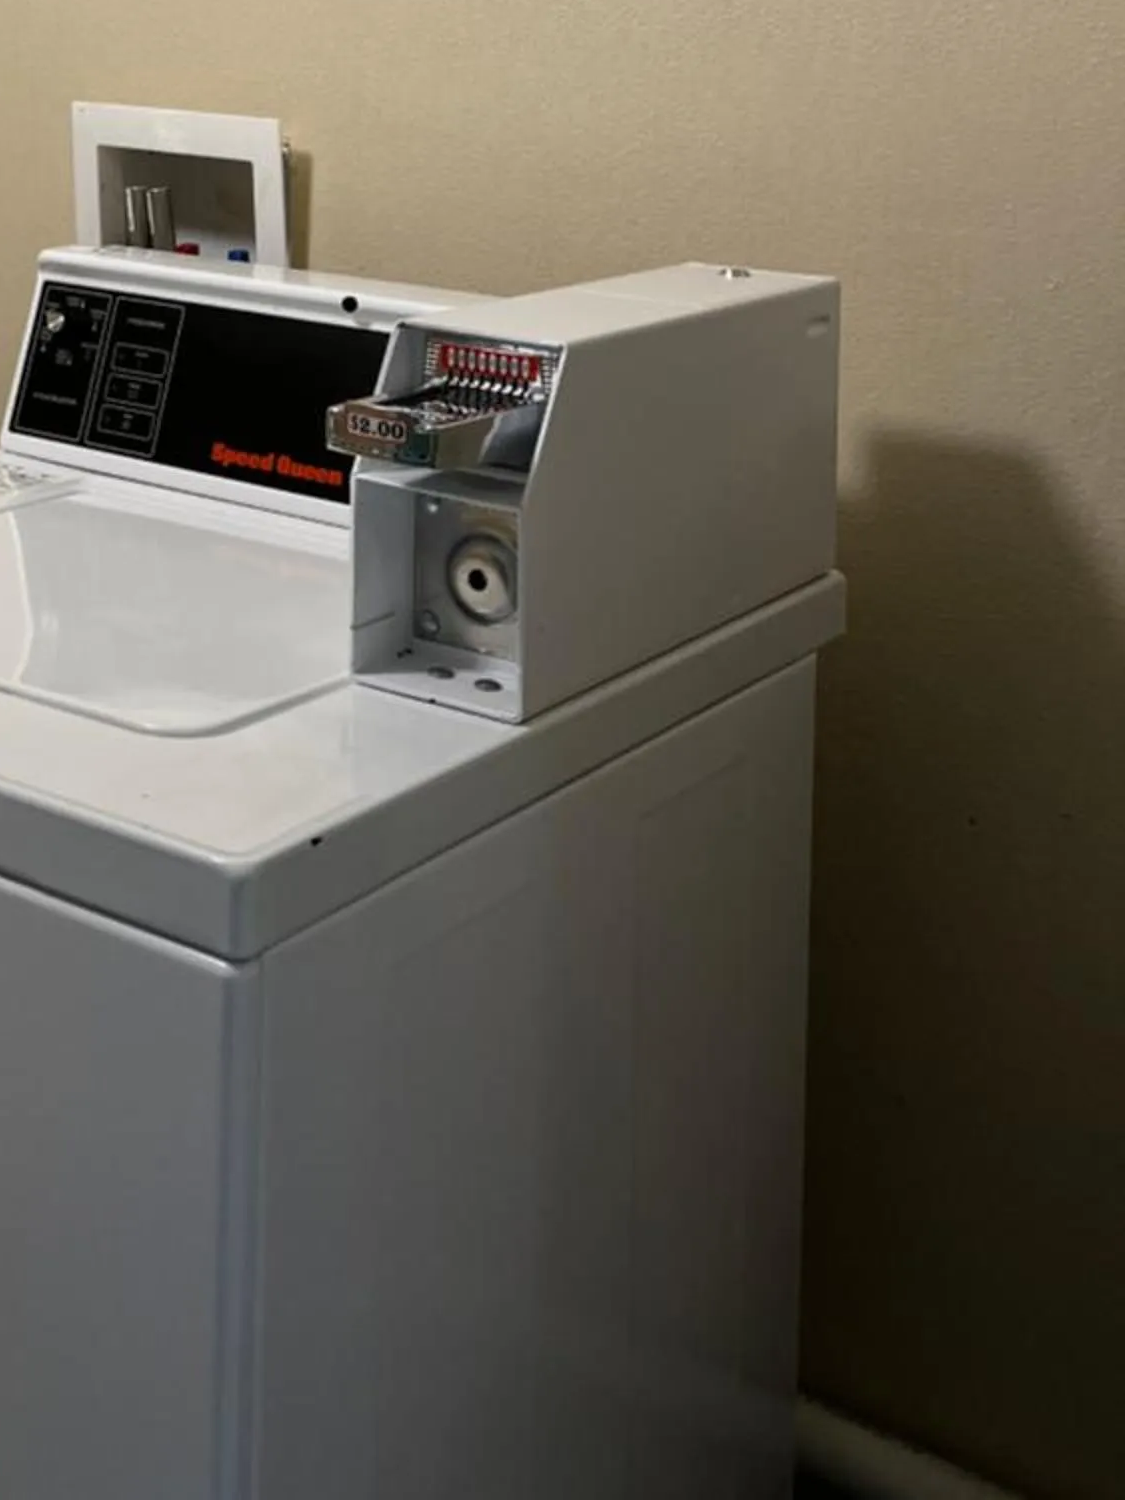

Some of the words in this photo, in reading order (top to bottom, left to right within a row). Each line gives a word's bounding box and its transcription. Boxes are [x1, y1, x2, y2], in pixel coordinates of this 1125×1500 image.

[349, 414, 404, 441] $2.00
[210, 440, 273, 476] Speed
[275, 454, 343, 486] Queen
